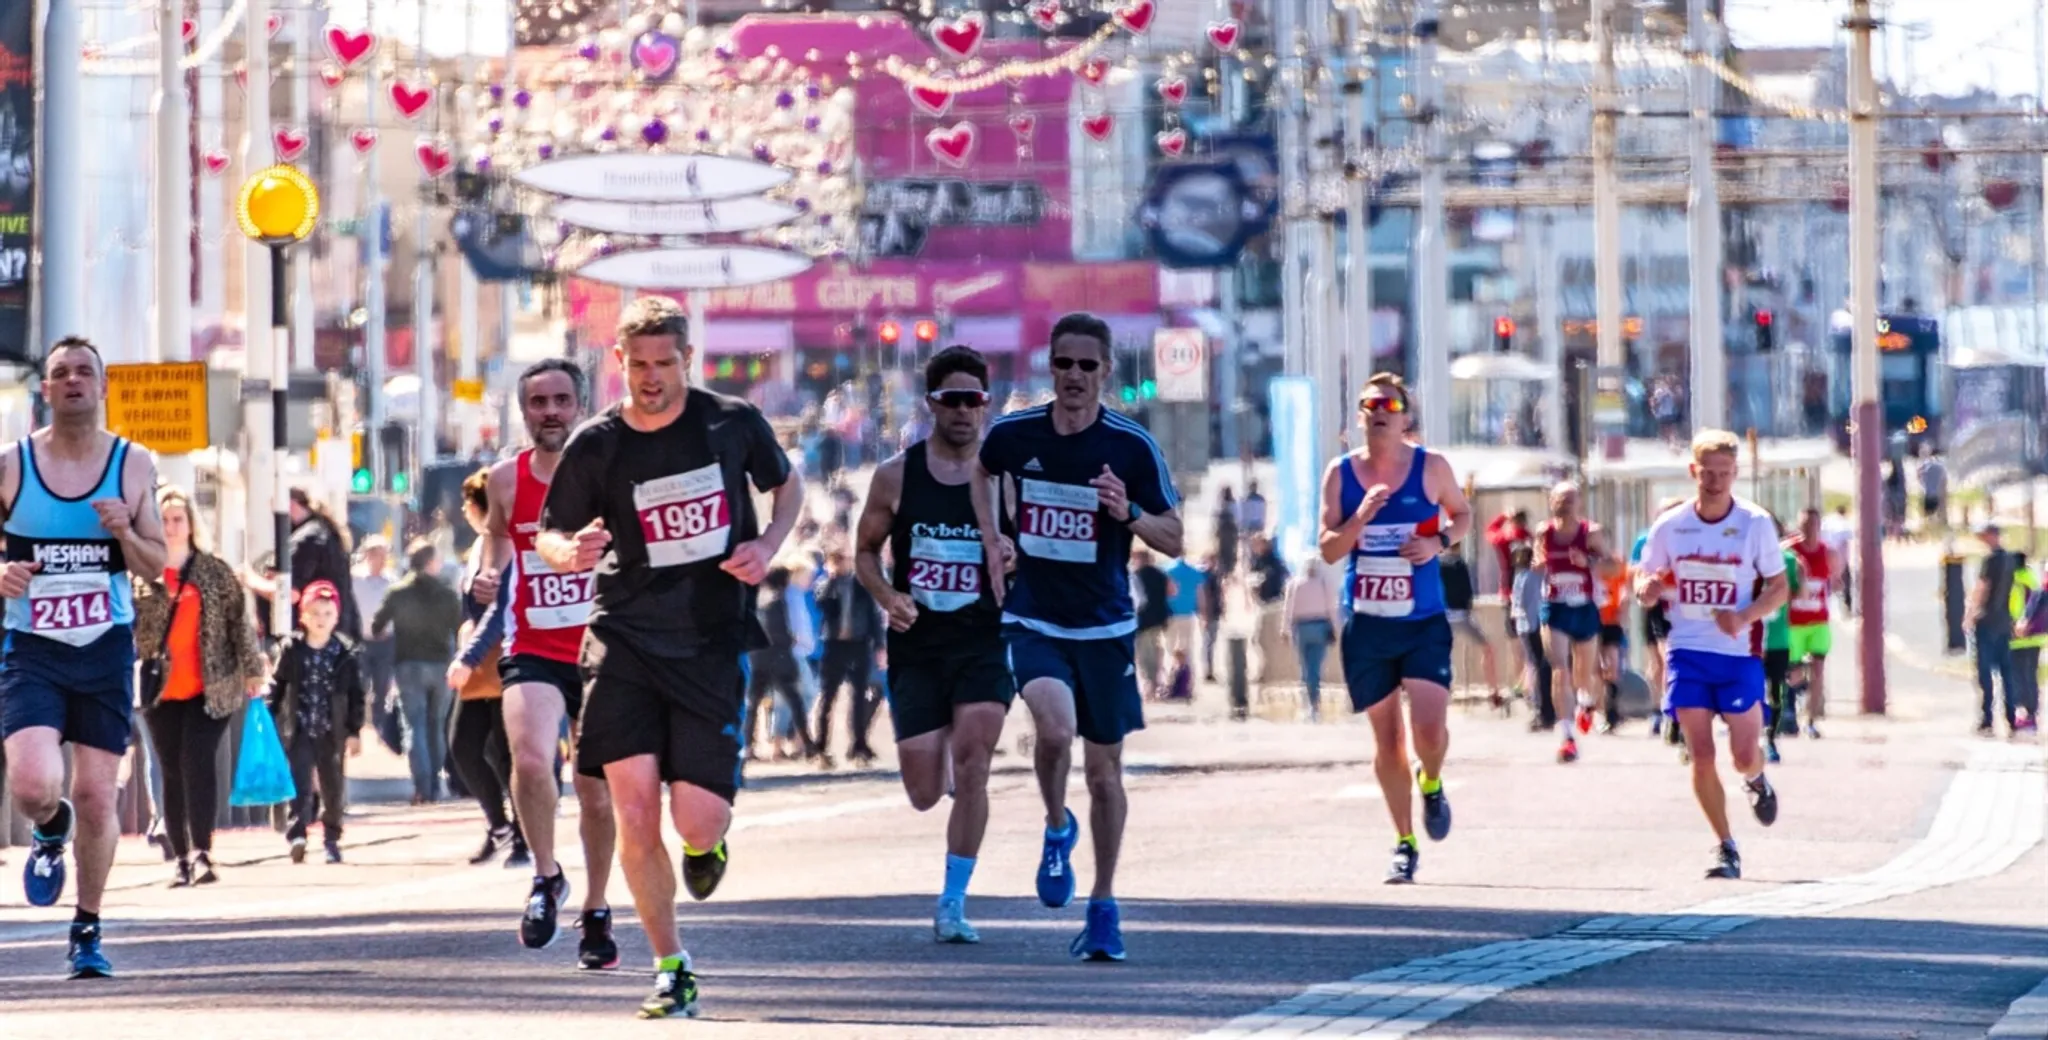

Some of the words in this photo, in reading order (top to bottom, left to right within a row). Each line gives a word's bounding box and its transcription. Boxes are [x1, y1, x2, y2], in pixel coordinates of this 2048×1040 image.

[108, 367, 204, 383] PEDESTRIANS
[121, 388, 137, 403] BE
[142, 388, 189, 404] AWARE
[123, 408, 191, 423] VEHICLES
[128, 427, 192, 443] TURNING
[645, 494, 722, 541] 1987
[1026, 505, 1094, 540] 1098
[911, 522, 984, 540] Cybele
[32, 543, 110, 564] WESHAM
[911, 560, 978, 593] 2319
[1359, 576, 1411, 601] 1749
[527, 572, 595, 607] 1857
[1682, 580, 1735, 605] 1517
[34, 592, 109, 629] 2414
